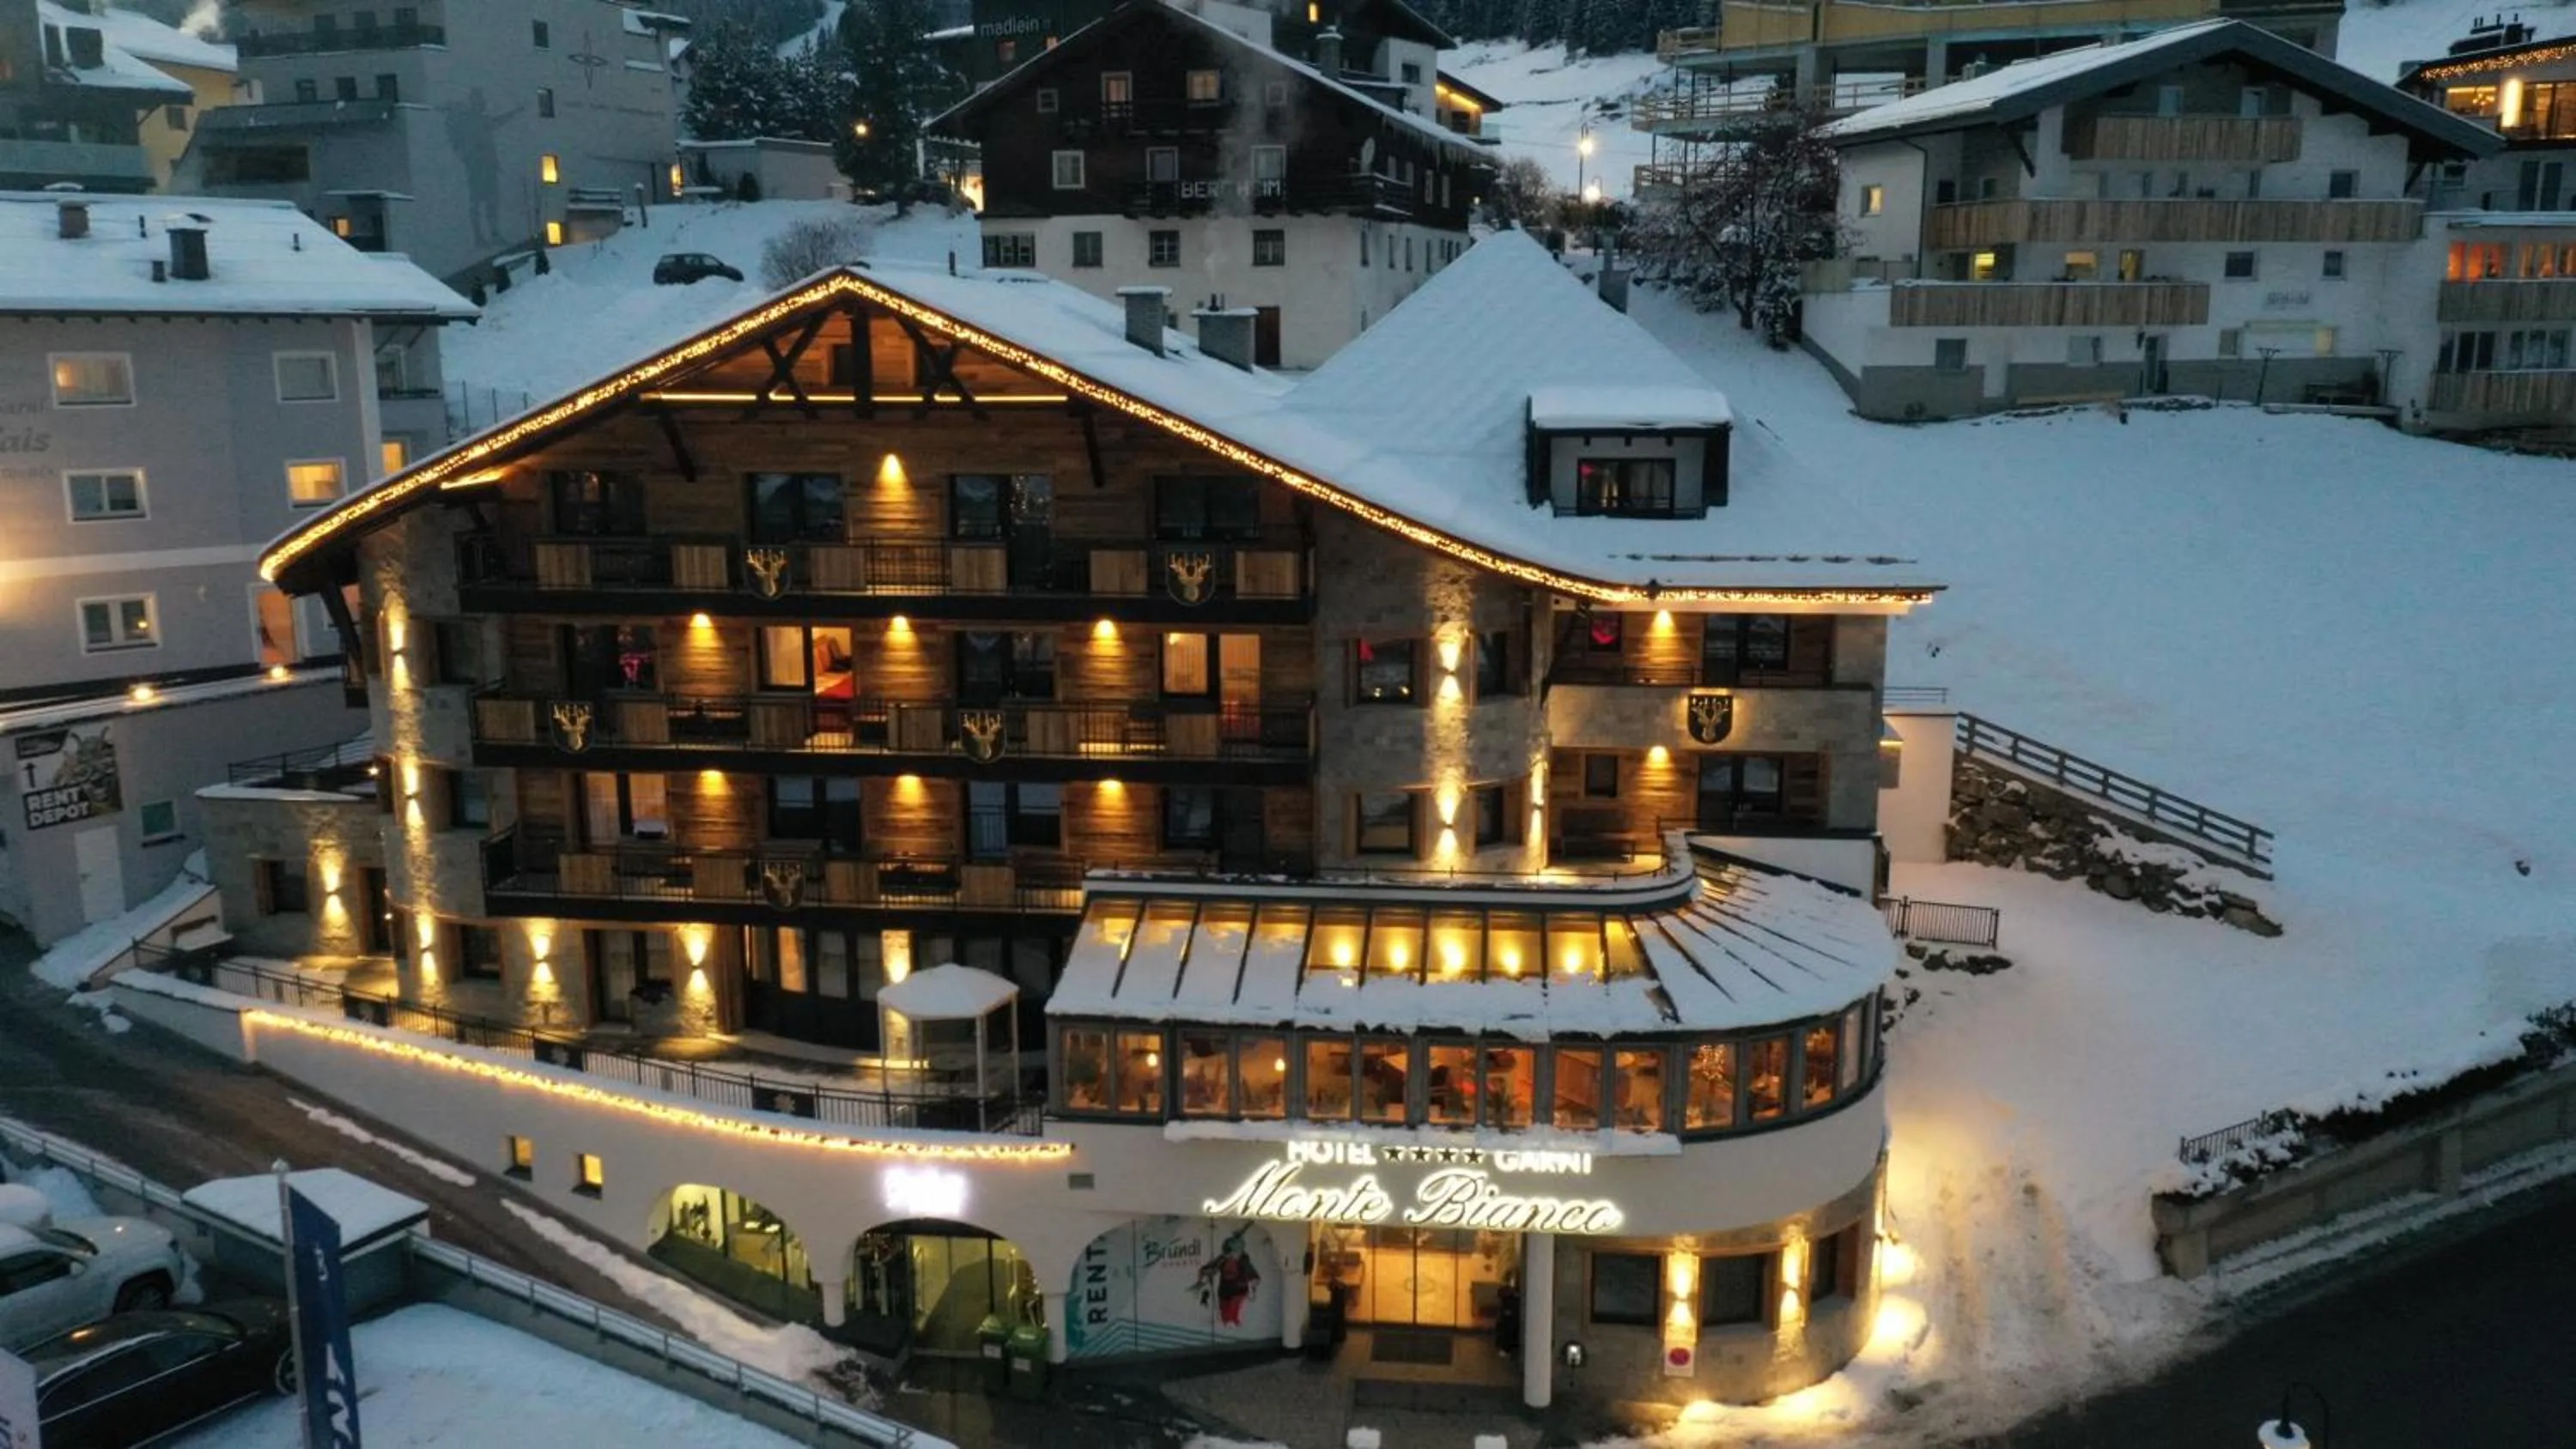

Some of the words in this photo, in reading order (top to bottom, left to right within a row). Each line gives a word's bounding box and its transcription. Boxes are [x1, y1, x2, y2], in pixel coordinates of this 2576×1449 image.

[981, 15, 1040, 35] madlein
[27, 788, 79, 811] RENT
[29, 802, 89, 826] DEPOT
[1287, 1141, 1377, 1165] HOTEL
[1494, 1151, 1592, 1174] GARNI
[1203, 1160, 1393, 1222] Monte
[1403, 1167, 1624, 1234] Bianco
